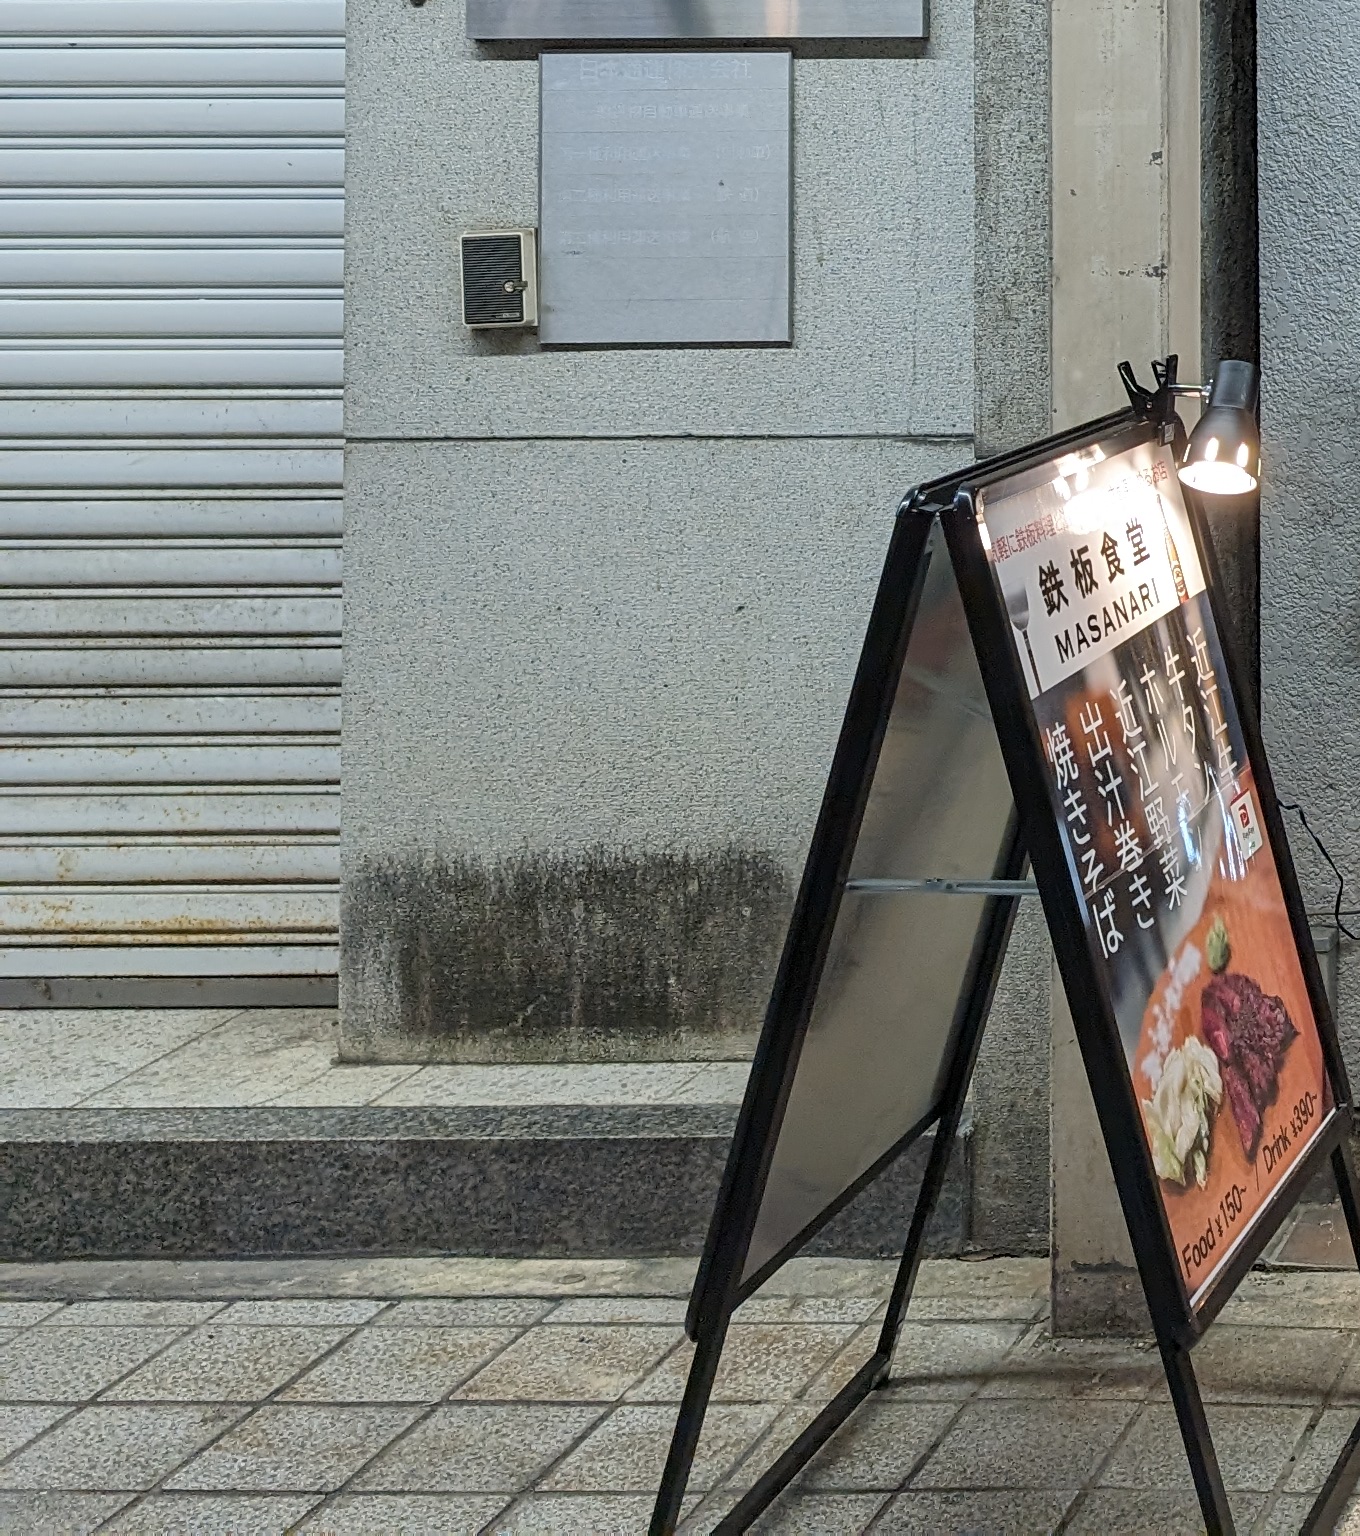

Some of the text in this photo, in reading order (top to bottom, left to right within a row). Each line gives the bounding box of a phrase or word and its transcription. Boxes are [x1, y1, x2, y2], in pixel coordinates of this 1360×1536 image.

[1038, 517, 1151, 617] 鉄板食堂
[1053, 577, 1161, 664] MASANARI
[1109, 678, 1188, 911] 近江野菜
[1163, 644, 1211, 805] 牛タン
[1045, 720, 1125, 960] 焼きそば
[1079, 700, 1155, 930] 出汁巻き
[1182, 1218, 1217, 1279] Food
[1262, 1124, 1291, 1176] Drink
